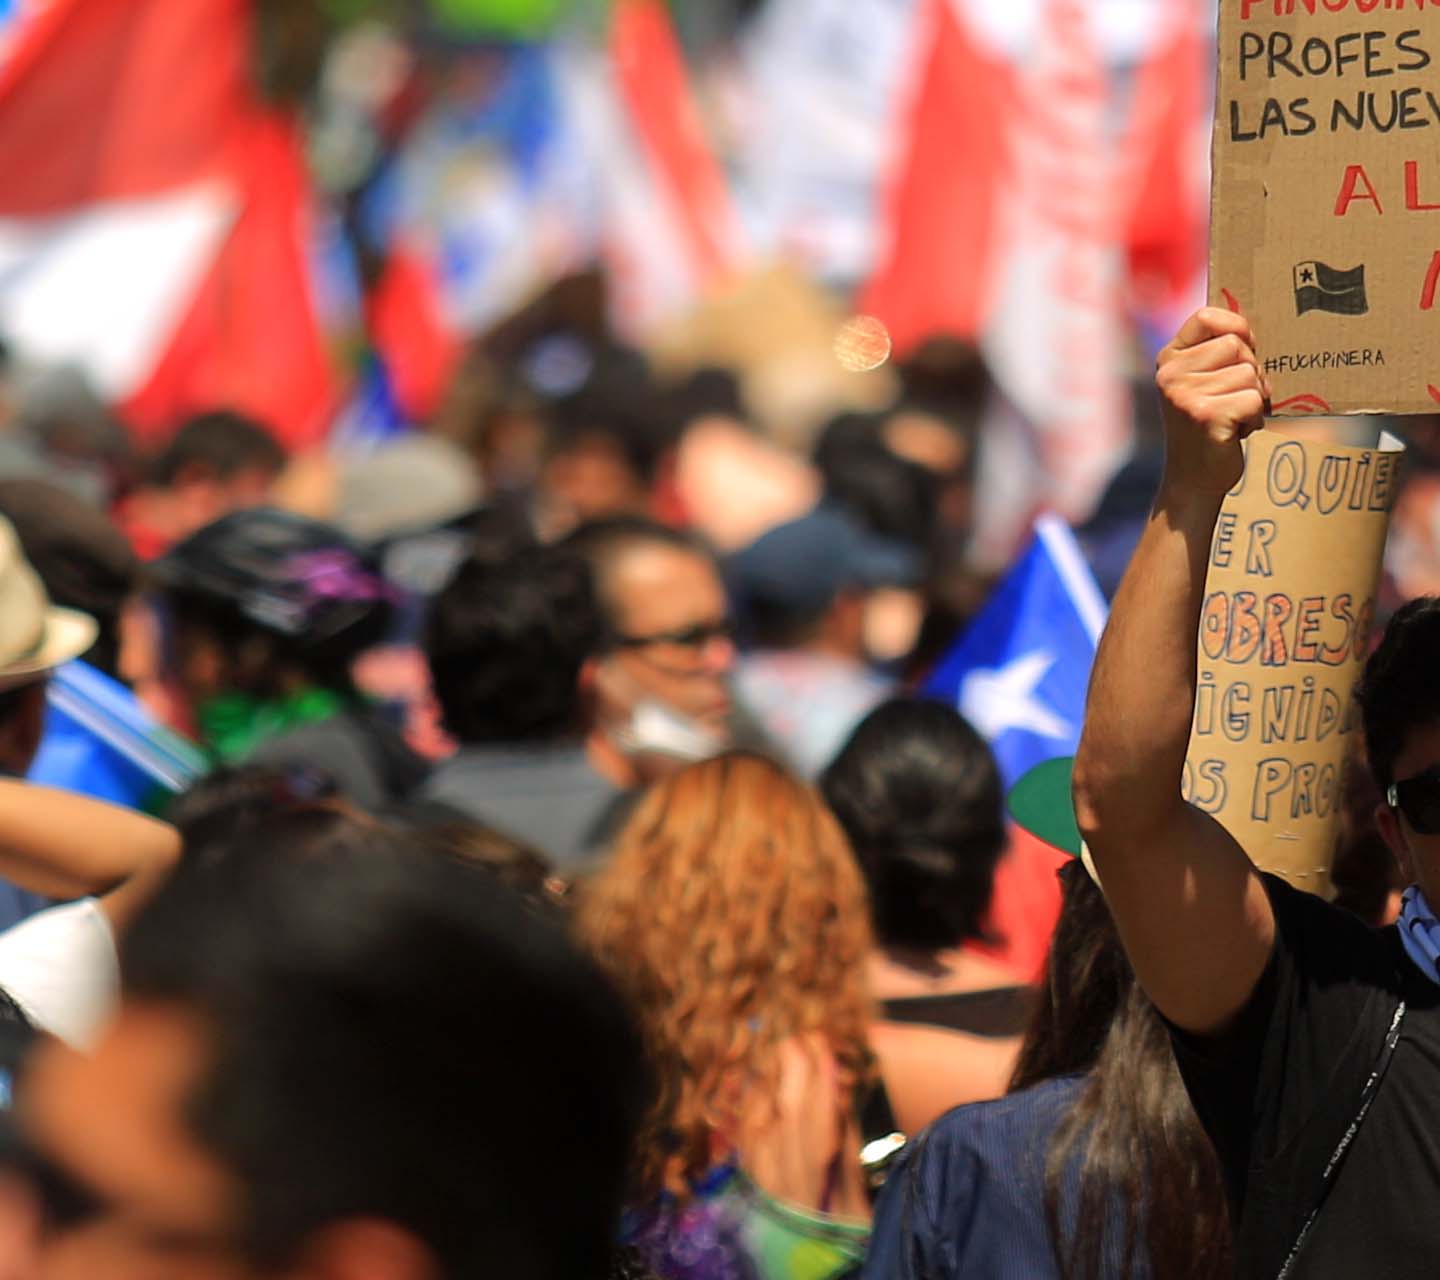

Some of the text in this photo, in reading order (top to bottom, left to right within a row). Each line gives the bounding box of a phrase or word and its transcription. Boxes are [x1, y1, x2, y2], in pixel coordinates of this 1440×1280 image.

[1240, 30, 1430, 80] PROFES
[1230, 98, 1316, 142] LAS
[1335, 165, 1382, 215] A
[1201, 591, 1354, 666] OBRES
